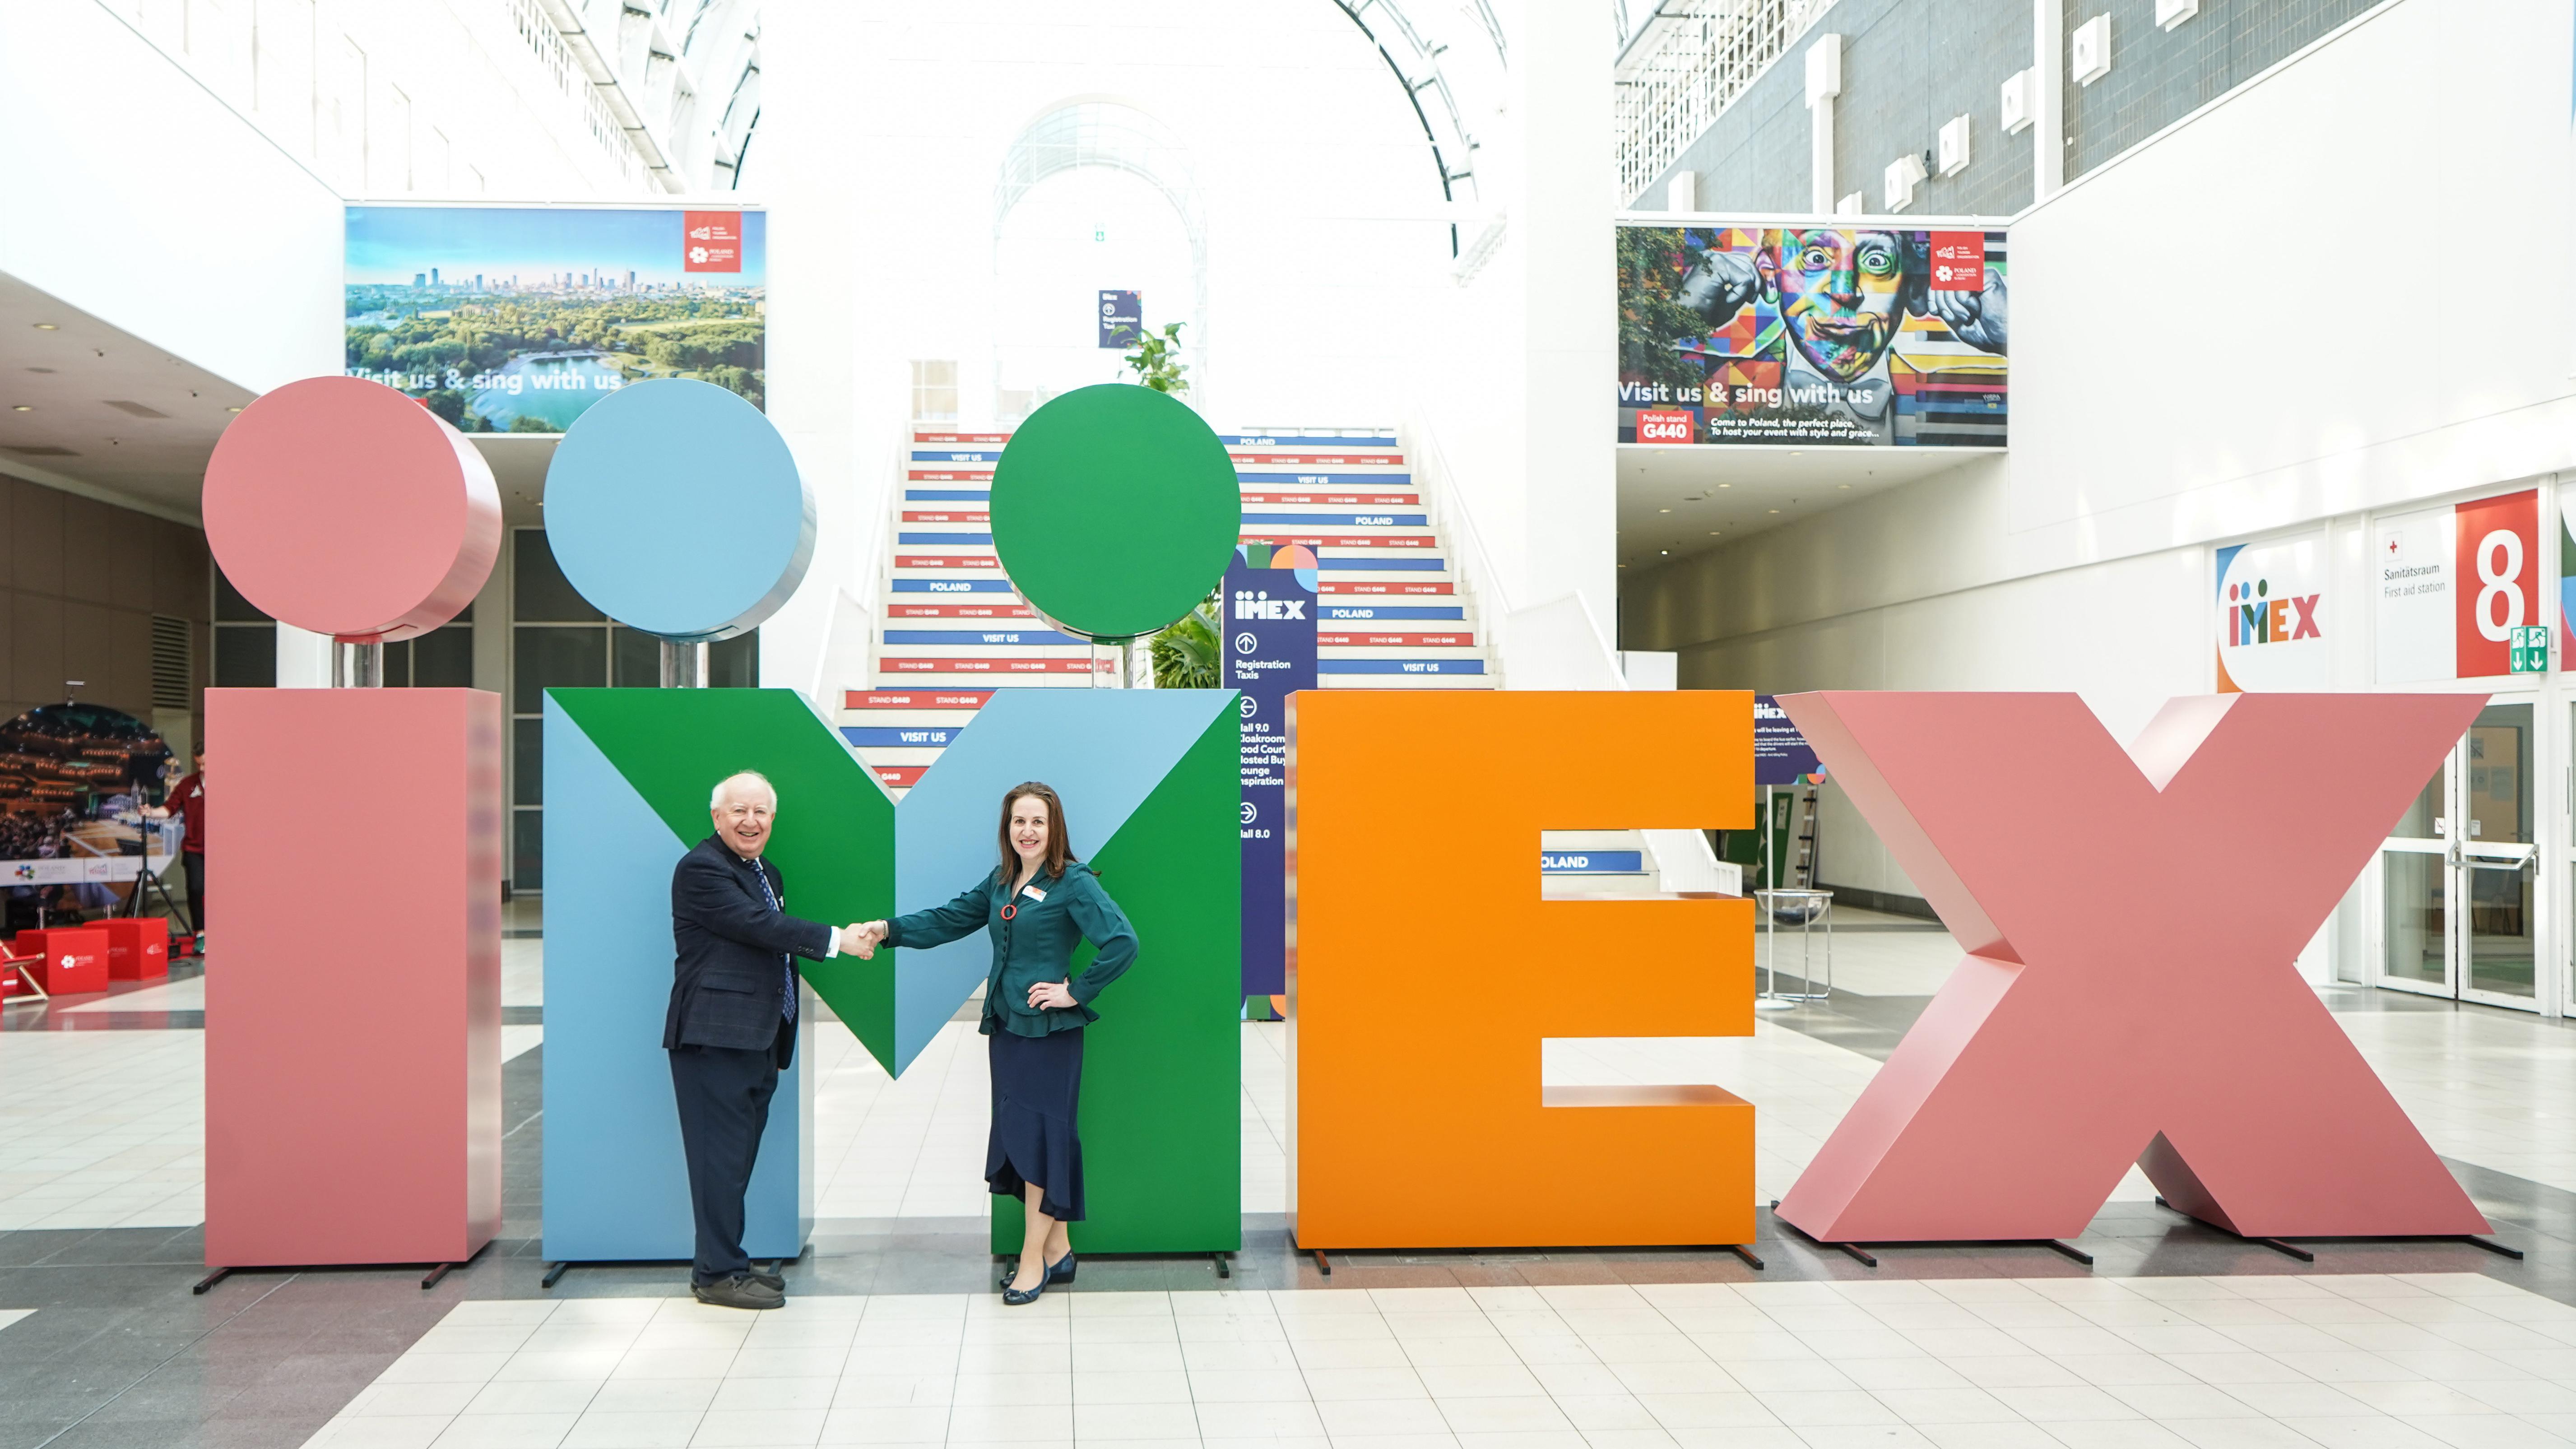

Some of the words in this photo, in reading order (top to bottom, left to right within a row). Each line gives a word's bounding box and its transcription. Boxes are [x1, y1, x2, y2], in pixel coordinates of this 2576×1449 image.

[409, 374, 437, 389] us
[445, 368, 465, 389] &
[472, 368, 522, 395] sing
[531, 368, 585, 390] with
[594, 375, 622, 390] us
[1618, 381, 1669, 401] Visit
[1676, 387, 1702, 402] us
[1709, 382, 1728, 402] &
[1736, 382, 1782, 408] sing
[1790, 382, 1840, 403] with
[1847, 389, 1873, 404] us
[1643, 414, 1665, 423] Polish
[1666, 414, 1687, 423] stand
[1711, 418, 1736, 426] Come
[1749, 418, 1780, 428] Poland,
[1782, 418, 1797, 427] the
[1798, 418, 1829, 429] perfect
[1829, 419, 1855, 429] place,
[1643, 423, 1687, 438] G440
[1711, 427, 1721, 436] To
[1722, 427, 1741, 436] host
[1742, 428, 1763, 438] your
[1789, 428, 1807, 437] with
[1809, 429, 1829, 439] style
[1830, 428, 1847, 437] and
[1355, 517, 1393, 525] POLAND
[2385, 565, 2440, 581] Sanitätsraum
[930, 583, 971, 591] POLAND
[2385, 586, 2401, 599] First
[2404, 583, 2415, 596] aid
[2418, 581, 2445, 594] station
[2475, 529, 2525, 642] 8
[1332, 609, 1373, 618] POLAND
[983, 634, 1006, 642] VISIT
[1007, 634, 1019, 642] US
[1235, 659, 1290, 670] Registration
[1403, 664, 1425, 672] VISIT
[1427, 664, 1439, 672] US
[1235, 670, 1259, 679] Taxis
[1240, 723, 1253, 732] all
[1255, 723, 1269, 732] 9.0
[900, 732, 929, 742] VISIT
[931, 732, 947, 742] US
[1240, 734, 1285, 743] loakroom
[1240, 745, 1258, 753] ood
[1240, 755, 1269, 764] osted
[1240, 768, 1270, 777] ounge
[1240, 776, 1284, 787] nspiration
[1240, 829, 1253, 838] all
[1255, 829, 1270, 838] 8.0
[1541, 856, 1588, 868] OLAND
